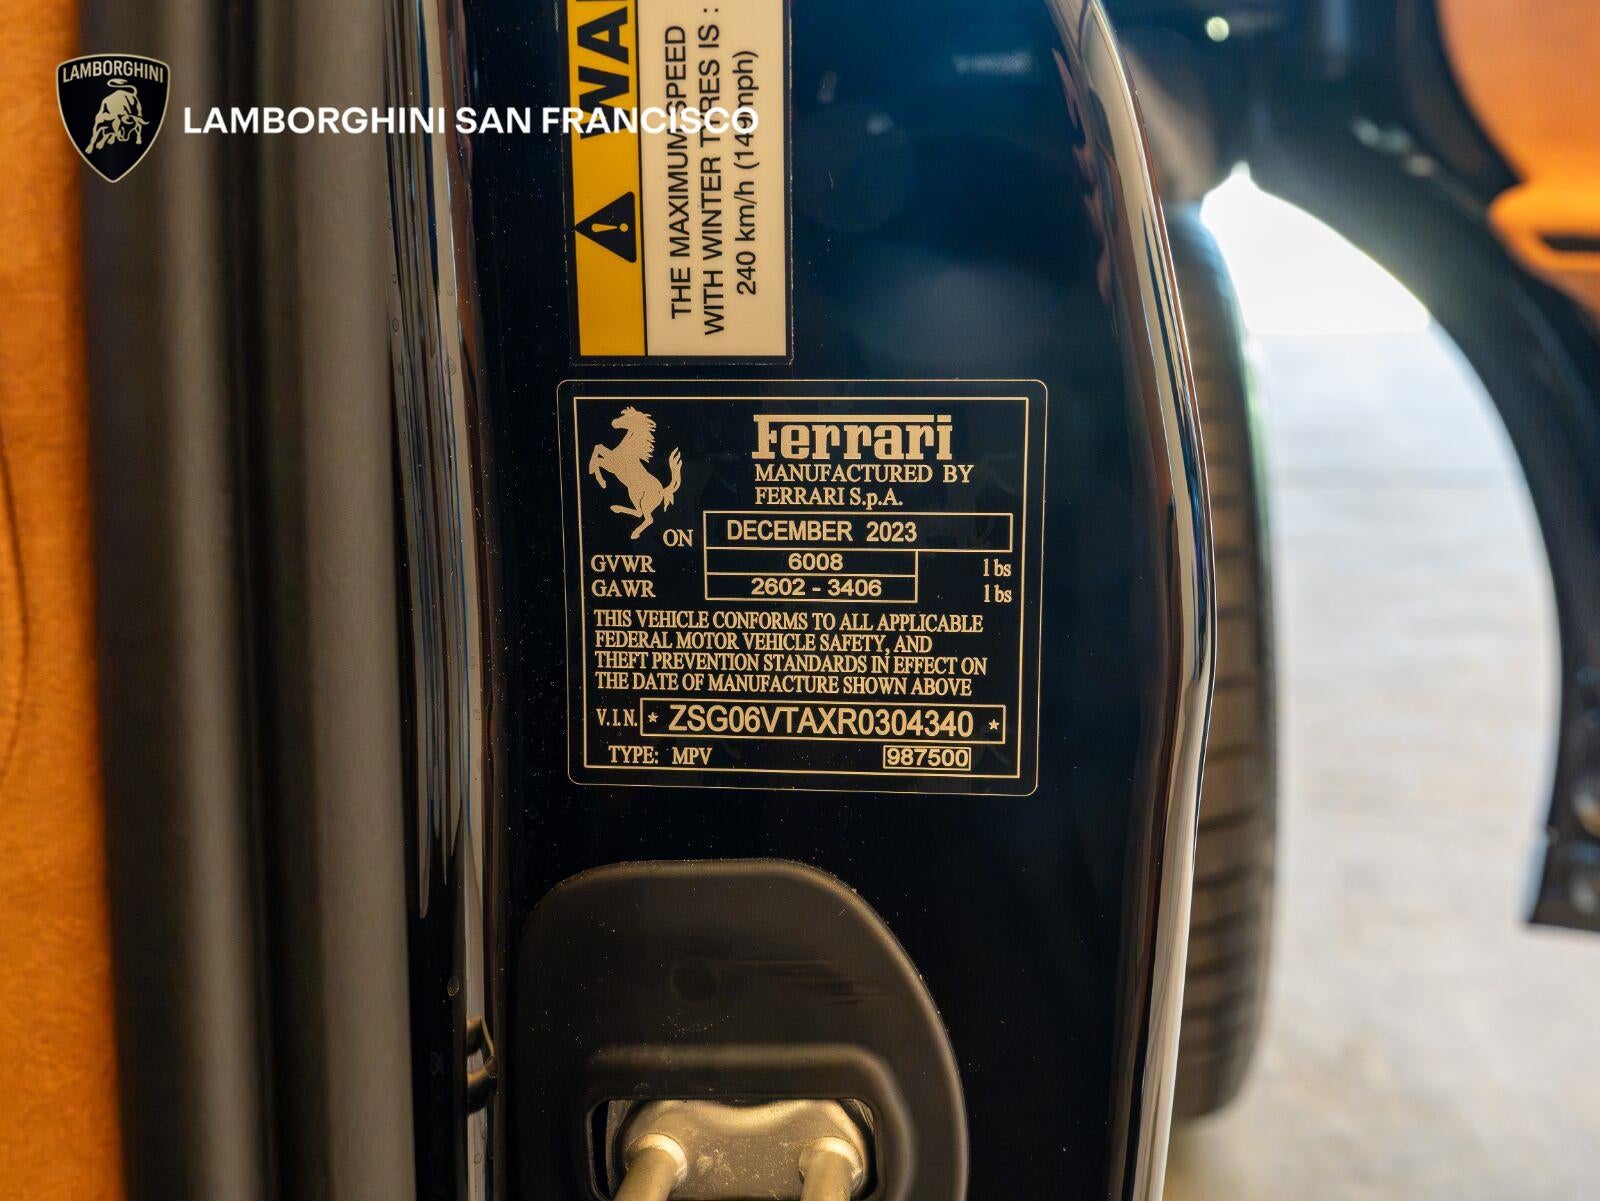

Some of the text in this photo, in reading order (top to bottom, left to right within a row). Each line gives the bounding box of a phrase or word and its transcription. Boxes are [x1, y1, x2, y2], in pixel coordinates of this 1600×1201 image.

[698, 24, 719, 48] IS
[577, 0, 630, 140] WA
[699, 59, 721, 147] TYRES
[665, 25, 692, 319] THE MAXIMUM SPEED
[700, 156, 723, 261] WINTER
[734, 180, 757, 243] km/h
[737, 252, 757, 295] 240
[702, 269, 725, 336] WITH
[752, 415, 952, 460] Ferrari
[754, 465, 974, 484] MANUFACTURED BY
[754, 487, 904, 510] FERRARI S.p.A.
[662, 520, 918, 548] ON DECEMBER 2023
[590, 555, 656, 574] GVWR
[787, 553, 844, 572] 6008
[591, 580, 657, 599] GAWR
[750, 578, 806, 596] 2602
[827, 578, 882, 597] 3406
[594, 610, 984, 634] THIS VEHICLE CONFORMS TO ALL APPLICABLE
[594, 631, 933, 656] FEDERAL MOTOR VEHICLE SAFETY, AND
[594, 652, 988, 676] THEFT PREVENTION STANDARDS IN EFFECT ON
[594, 672, 973, 697] THE DATE OF MANUFACTURE SHOWN ABOVE
[669, 704, 975, 738] ZSG06VTAXR0304340
[608, 745, 713, 766] TYPE: MPV
[886, 749, 969, 768] 987500
